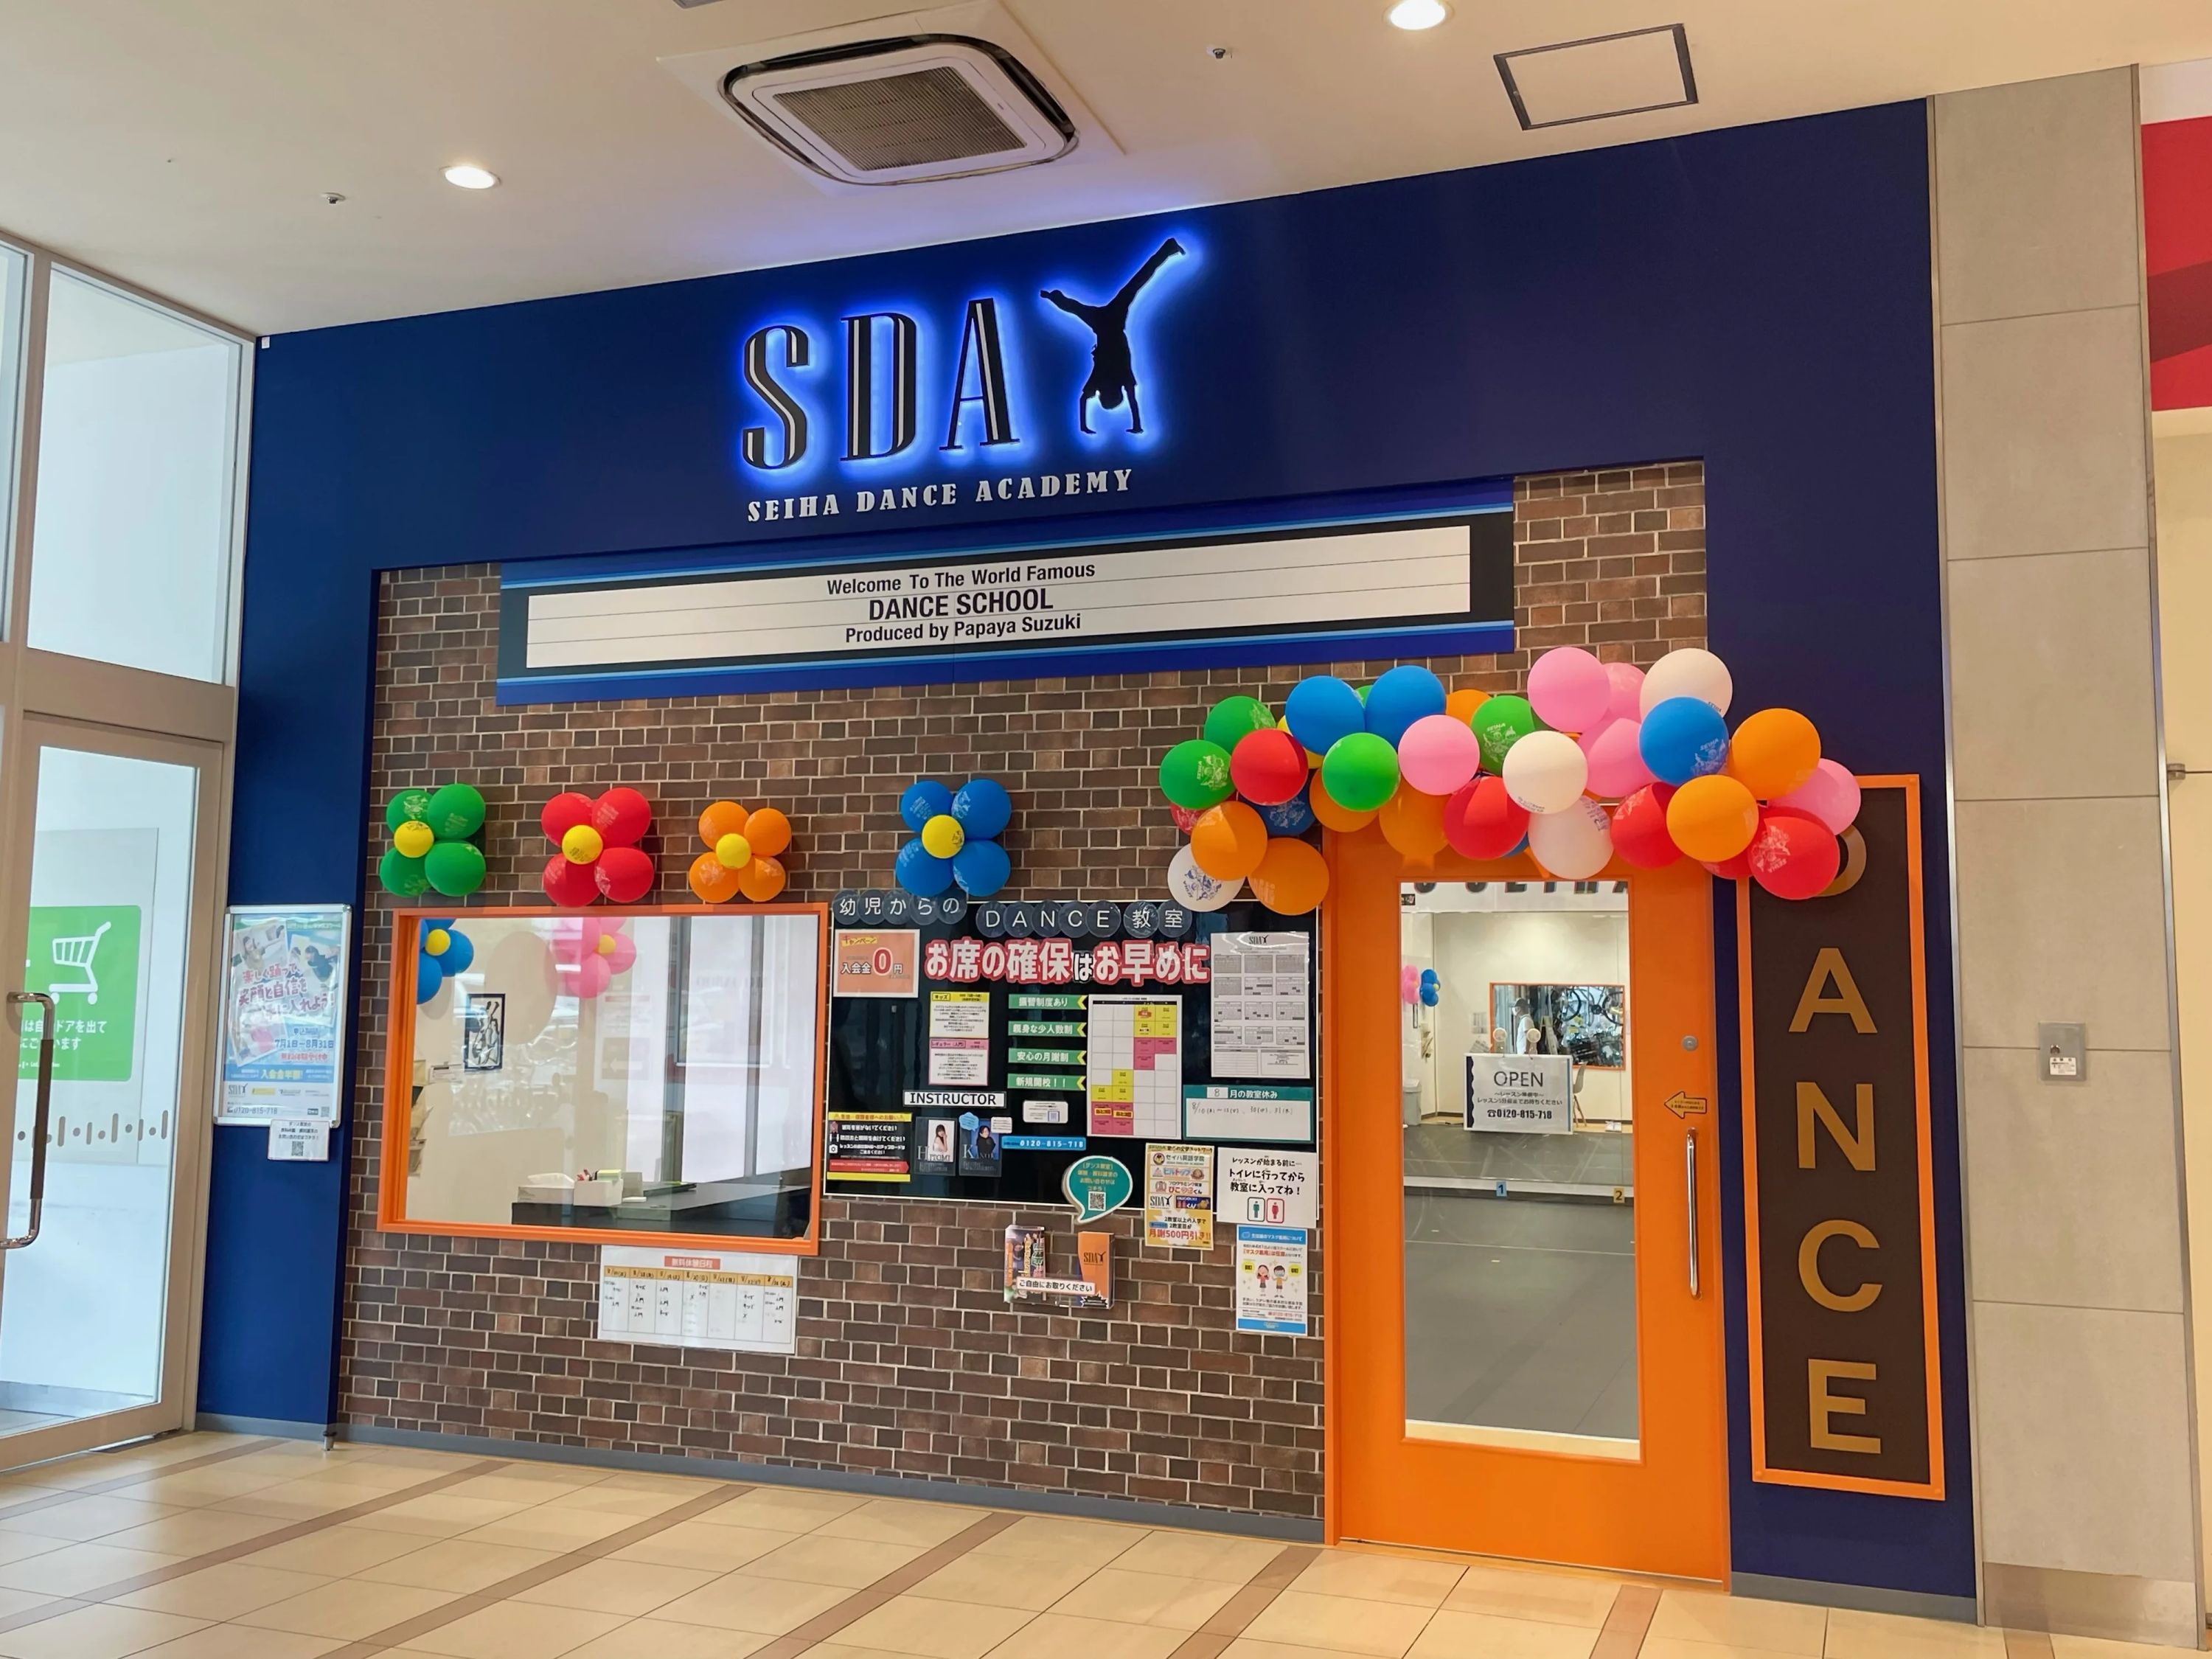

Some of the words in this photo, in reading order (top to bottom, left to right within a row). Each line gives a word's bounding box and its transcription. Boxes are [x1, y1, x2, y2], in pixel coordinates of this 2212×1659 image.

[747, 495, 840, 523] SEIHA
[856, 482, 958, 513] DANCE
[975, 468, 1133, 503] ACADEMY
[827, 578, 902, 595] Welcome
[910, 574, 930, 590] To
[934, 571, 965, 588] The
[972, 566, 1020, 585] World
[1027, 563, 1096, 581] Famous
[869, 594, 950, 621] DANCE
[956, 588, 1054, 616] SCHOOL
[845, 623, 924, 644] Produced
[929, 623, 950, 641] by
[954, 621, 1016, 639] Papaya
[1021, 613, 1082, 632] Suzuki
[839, 897, 960, 917] 幼児からの
[841, 935, 877, 947] キャンペーン
[927, 939, 1209, 984] お席の確保はお早めに
[238, 977, 307, 1007] 笑顔と自信を
[1012, 1023, 1073, 1034] 親身な少人数制
[1017, 1051, 1069, 1062] 安心の月謝制
[1493, 1071, 1544, 1088] OPEN
[909, 1092, 997, 1106] INSTRUCTOR
[1496, 1109, 1553, 1120] 0120-815-718
[1229, 1169, 1305, 1182] トイレに行ってから
[1230, 1181, 1301, 1195] 教室に入ってね！
[1498, 1184, 1504, 1194] 1
[1615, 1191, 1623, 1200] 2
[1019, 1280, 1093, 1292] ご自由にお取りください
